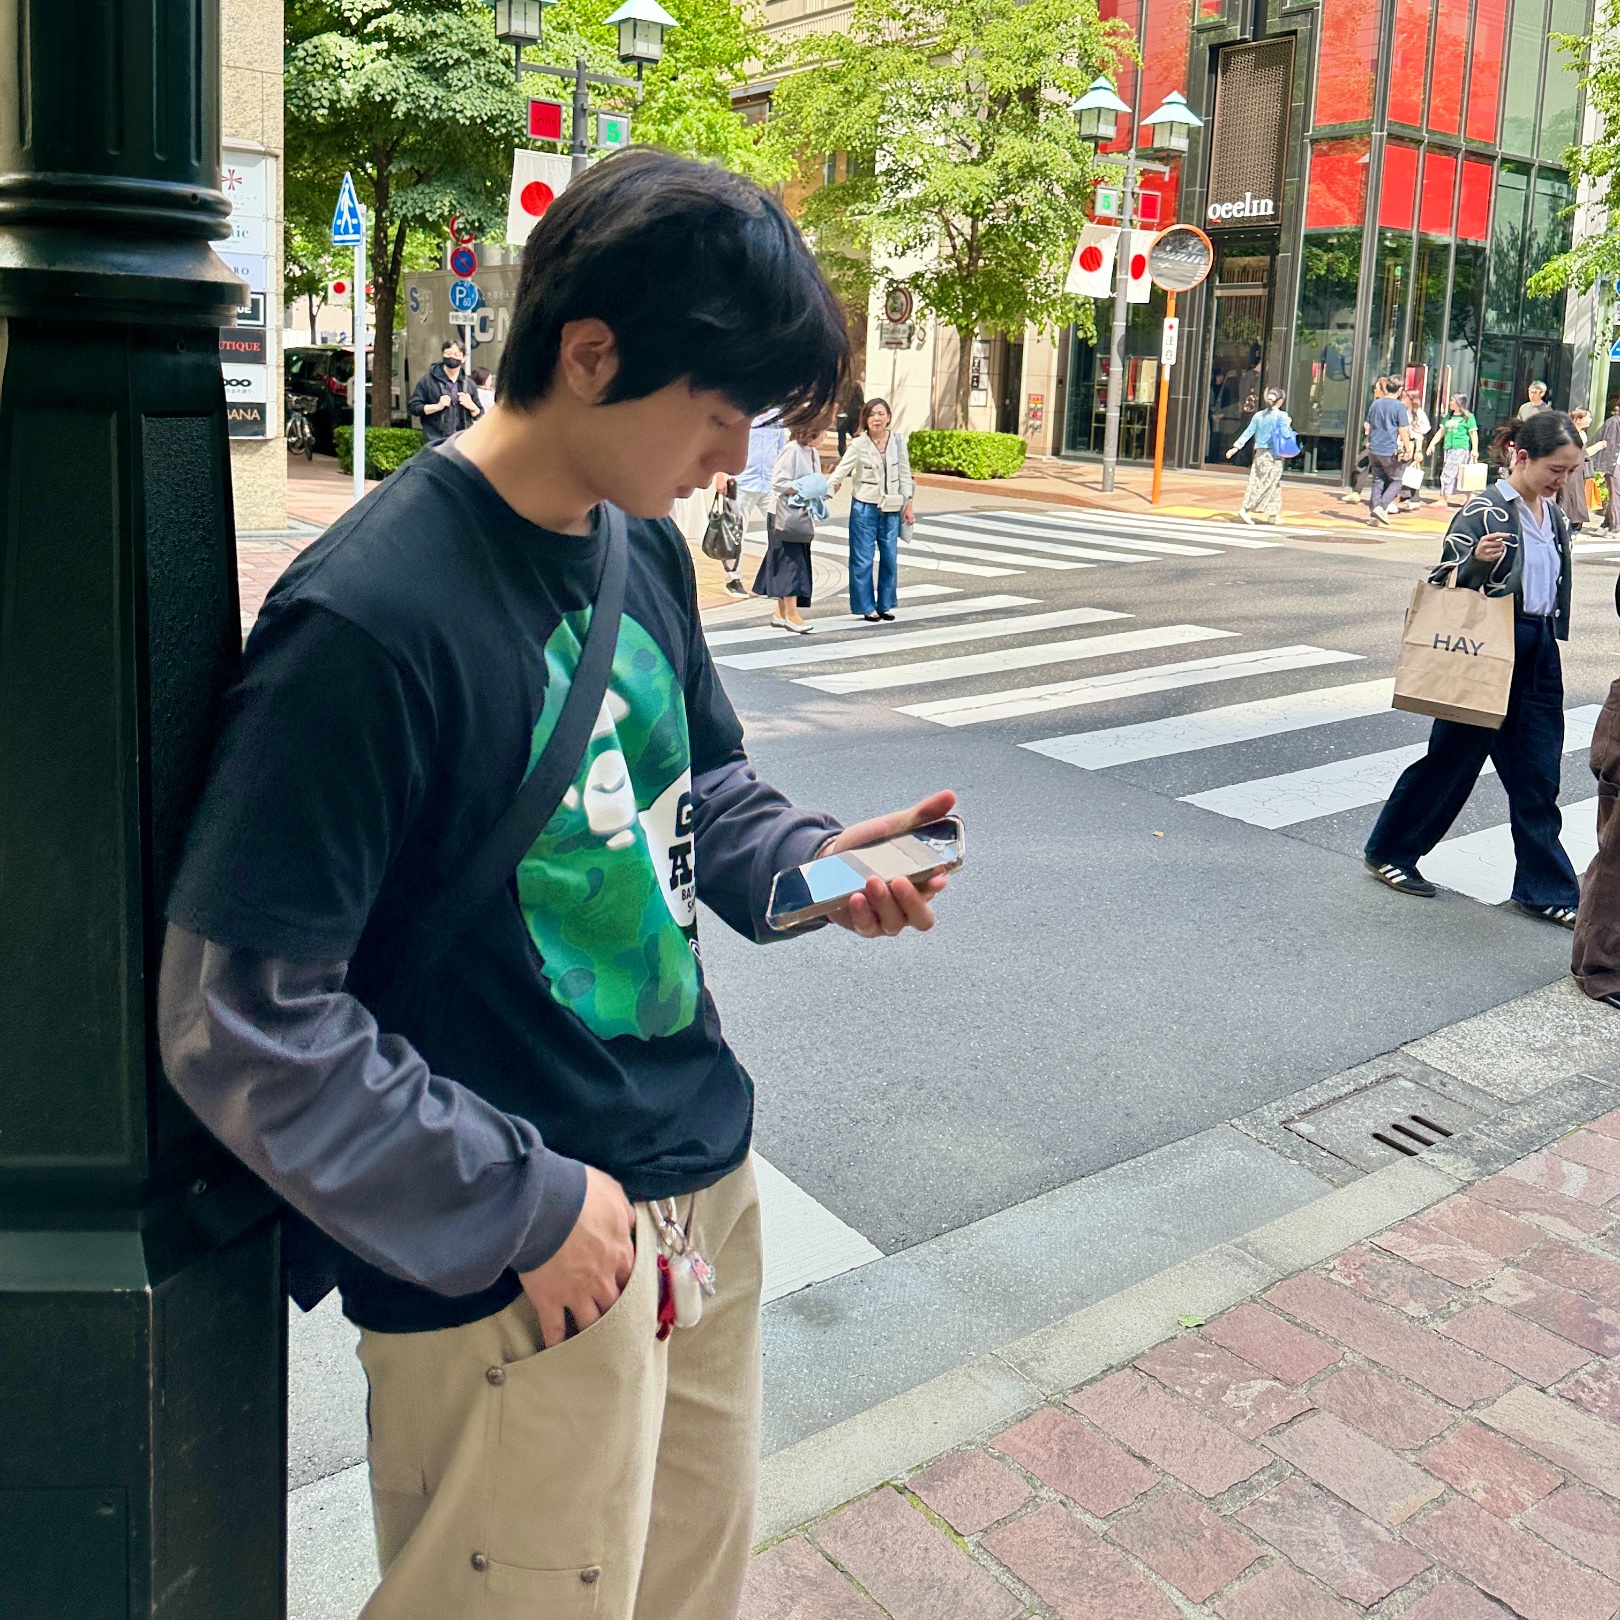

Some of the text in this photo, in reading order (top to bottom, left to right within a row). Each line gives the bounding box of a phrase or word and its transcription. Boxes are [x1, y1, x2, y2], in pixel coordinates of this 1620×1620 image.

[606, 121, 620, 142] 5
[1101, 194, 1111, 210] 5
[455, 286, 467, 307] P
[1432, 633, 1485, 656] HAY
